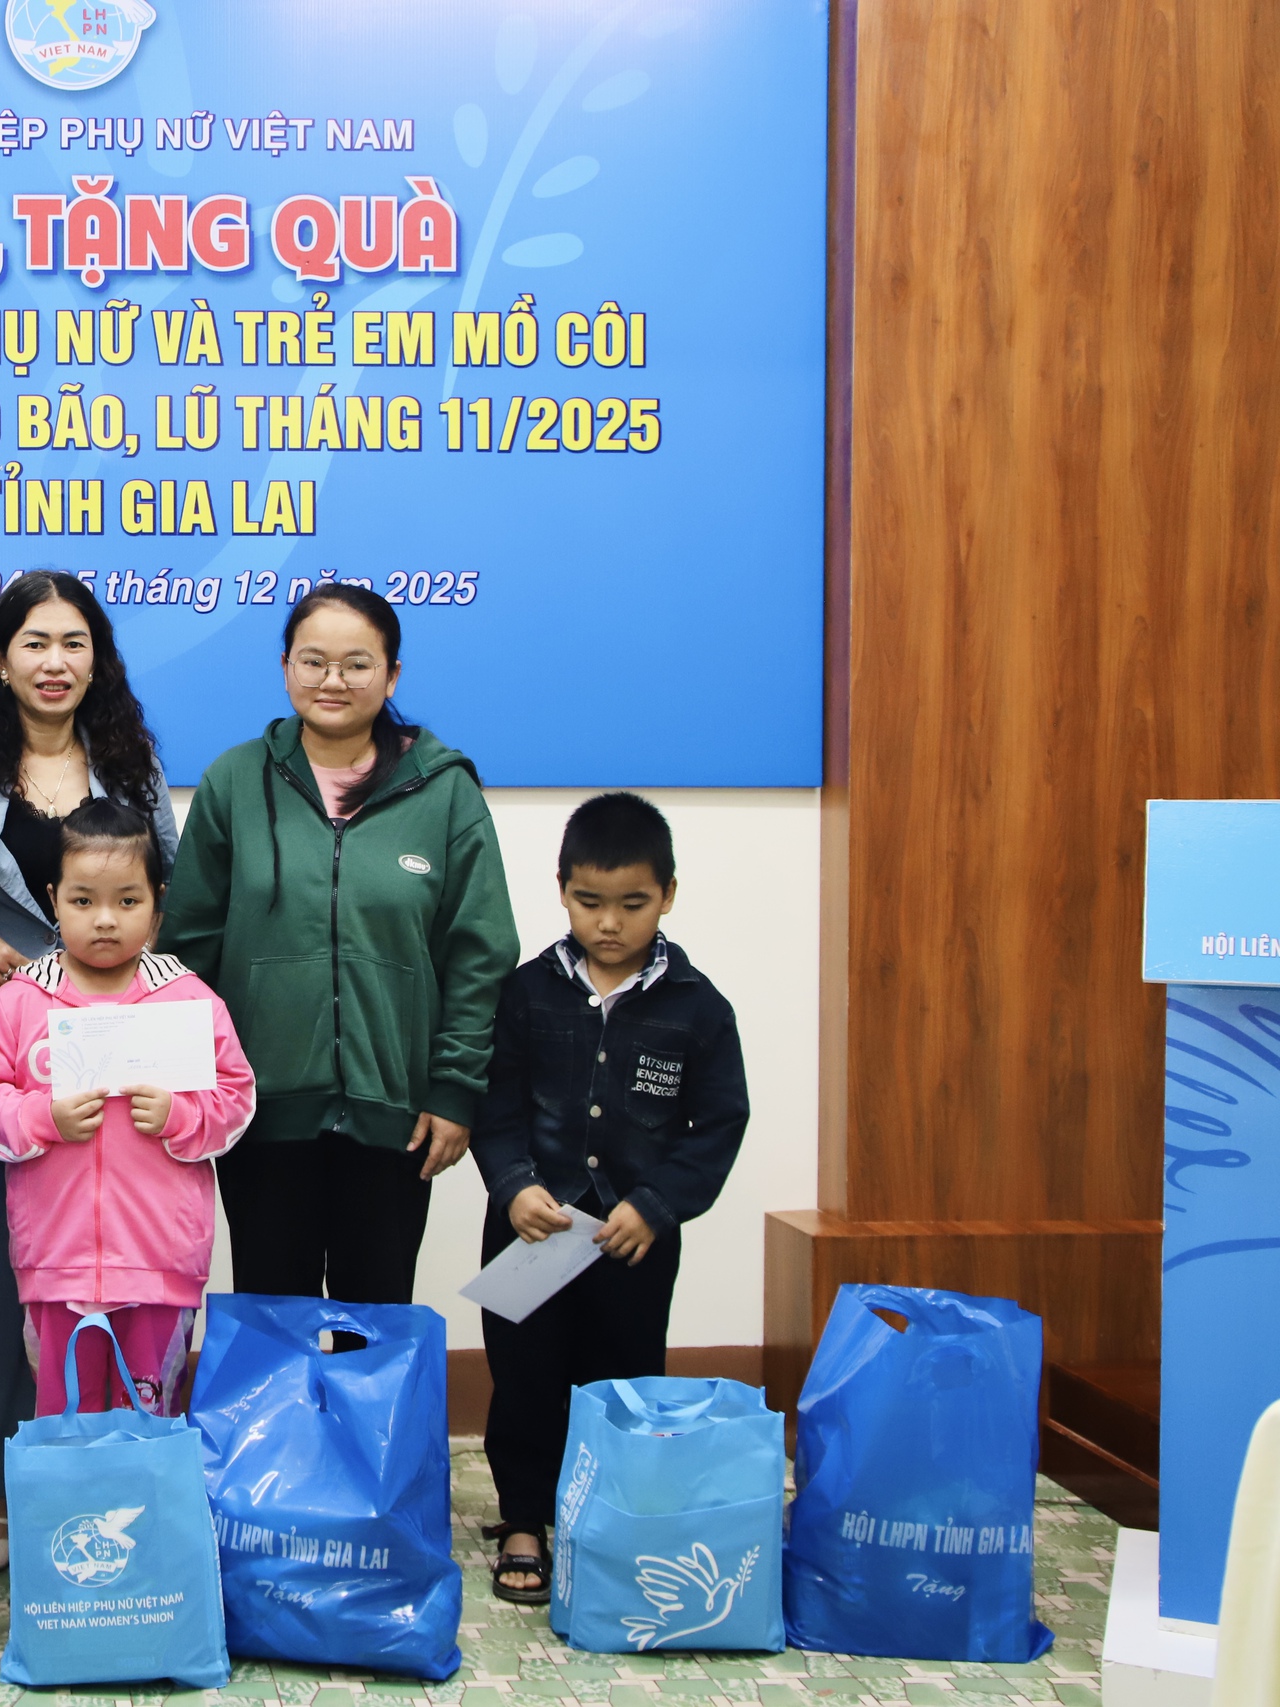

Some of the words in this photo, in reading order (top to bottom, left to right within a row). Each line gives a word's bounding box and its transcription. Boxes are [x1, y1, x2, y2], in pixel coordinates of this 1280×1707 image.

[39, 44, 71, 58] VIET
[77, 44, 108, 58] NAM
[60, 118, 142, 157] PHỤ
[156, 112, 216, 151] NỮ
[224, 110, 315, 157] VIỆT
[326, 119, 414, 152] NAM
[13, 175, 250, 288] TẶNG
[273, 176, 462, 283] QUÀ
[55, 299, 142, 366] NỮ
[152, 299, 222, 366] VÀ
[234, 293, 336, 366] TRẺ
[352, 311, 435, 366] EM
[452, 292, 539, 367] MỒ
[555, 301, 647, 368] CÔI
[17, 383, 139, 458] BÃO,
[155, 385, 220, 452] LŨ
[235, 385, 421, 453] THÁNG
[439, 395, 661, 454] 11/2025
[121, 479, 217, 536] GIA
[232, 479, 316, 536] LAI
[105, 568, 221, 614] tháng
[234, 570, 279, 605] 12
[384, 569, 480, 606] 2025
[1201, 931, 1235, 960] HỘI
[231, 1520, 274, 1555] LHPN
[279, 1526, 320, 1564] TỈNH
[323, 1539, 352, 1568] GIA
[359, 1545, 390, 1570] LAI
[842, 1510, 876, 1548] HỘI
[879, 1520, 928, 1551] LHPN
[934, 1517, 974, 1555] TỈNH
[978, 1526, 1004, 1555] GIA
[24, 1601, 41, 1615] HỘI
[42, 1601, 66, 1614] LIÊN
[67, 1600, 91, 1614] HIỆP
[93, 1600, 116, 1613] PHỤ
[118, 1597, 134, 1610] NỮ
[134, 1595, 158, 1611] VIỆT
[160, 1592, 184, 1606] NAM
[906, 1573, 966, 1602] Tặng
[37, 1619, 58, 1630] VIET
[61, 1618, 87, 1629] NAM
[89, 1614, 140, 1627] WOMEN'S
[141, 1611, 174, 1623] UNION
